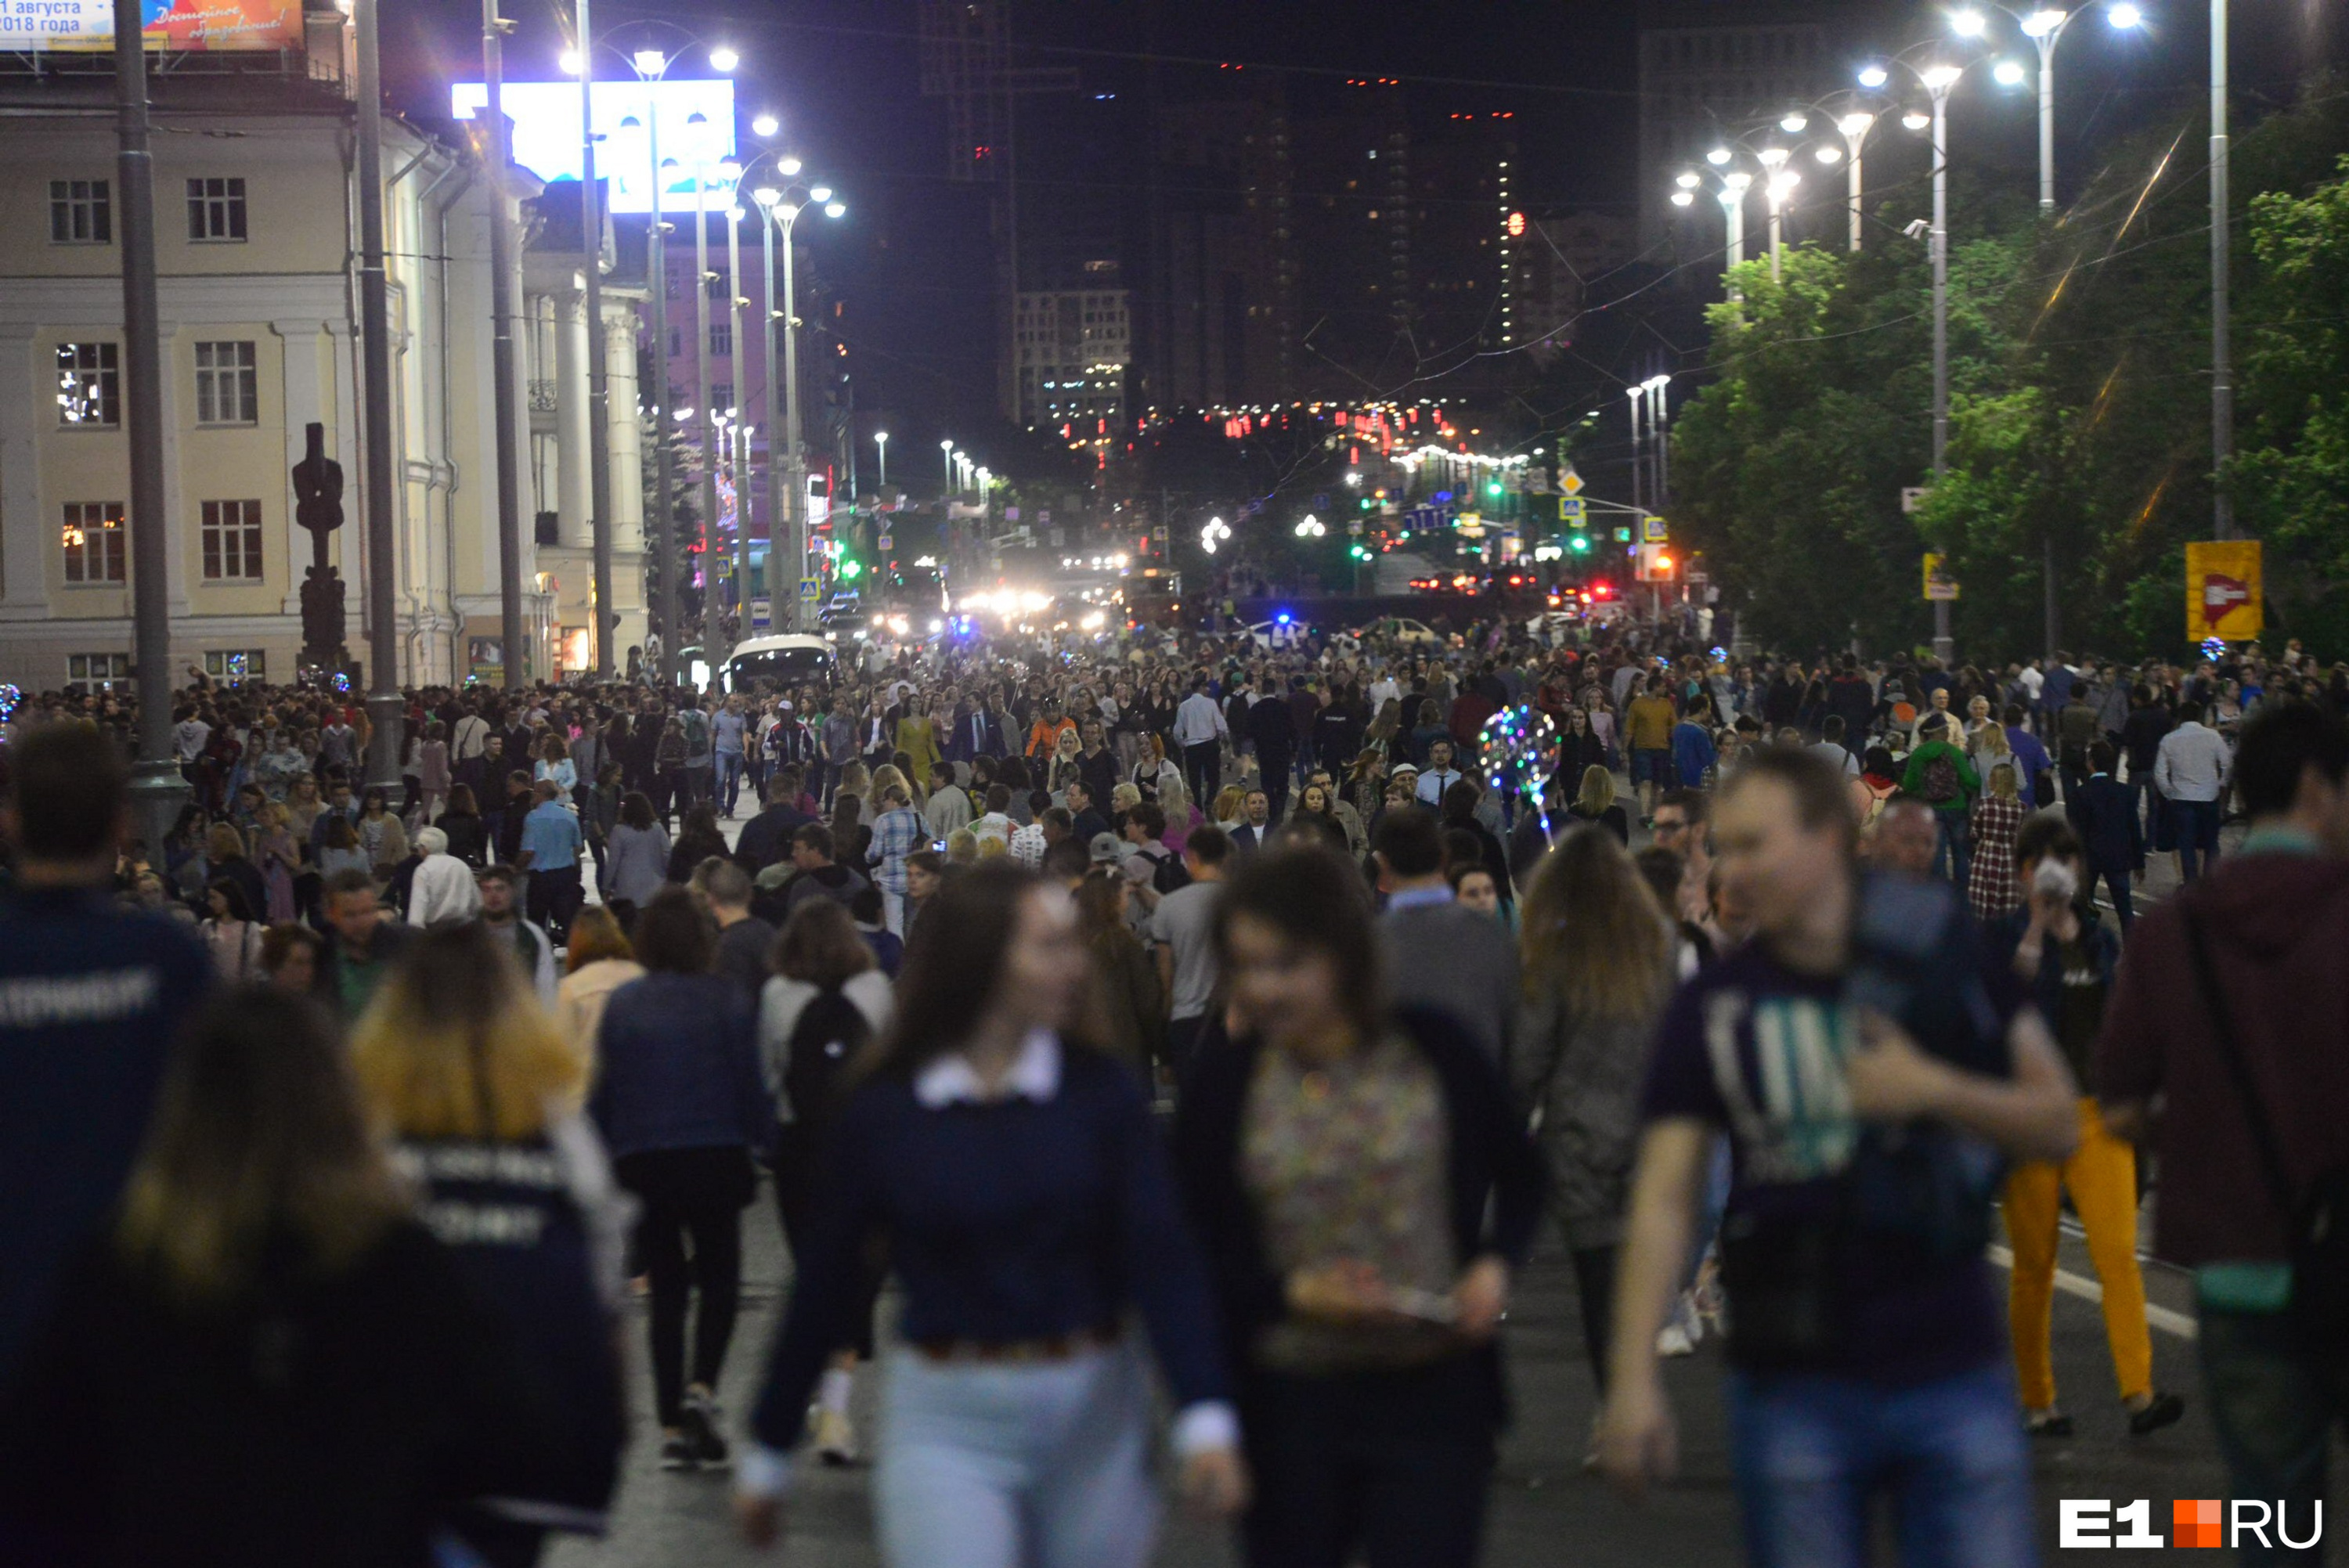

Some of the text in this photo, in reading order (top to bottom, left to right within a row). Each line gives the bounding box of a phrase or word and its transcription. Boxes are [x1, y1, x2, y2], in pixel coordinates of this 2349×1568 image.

[16, 2, 81, 16] августа
[155, 5, 240, 24] Достойное
[0, 16, 80, 34] 018 года
[189, 8, 287, 43] образование!
